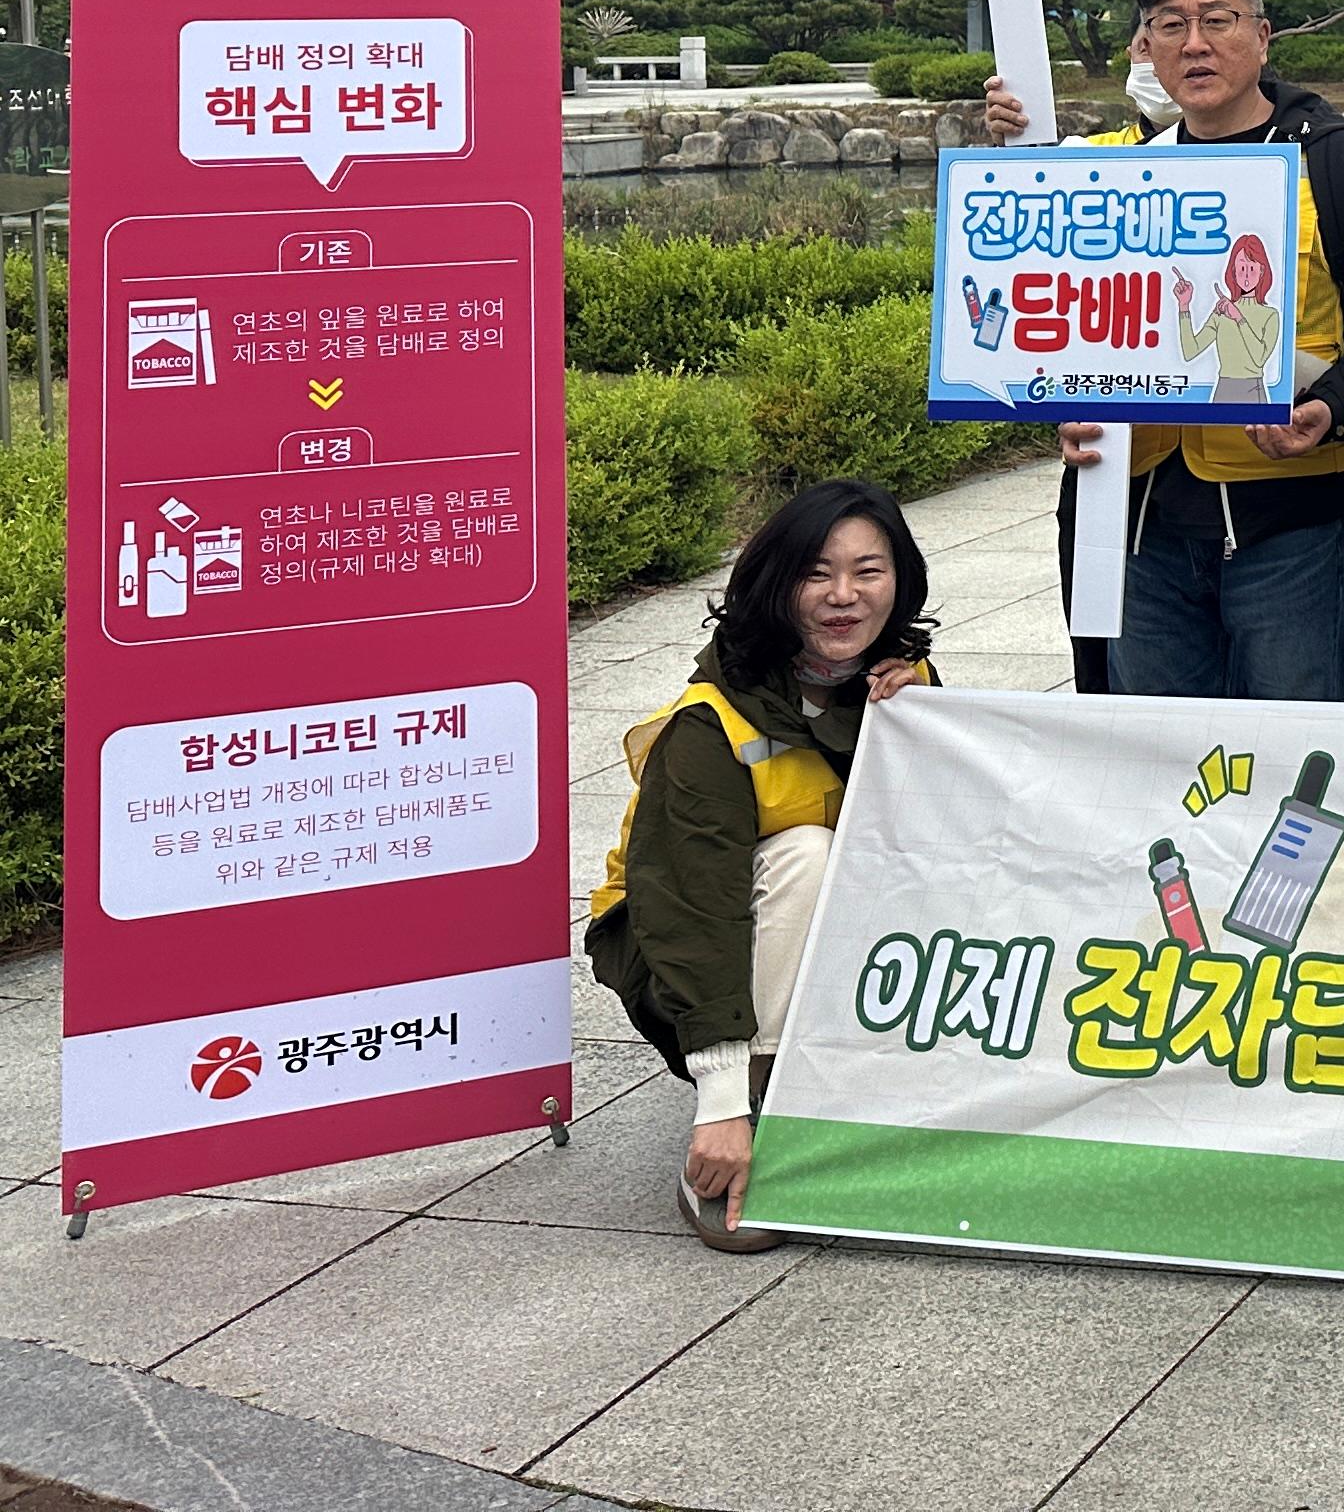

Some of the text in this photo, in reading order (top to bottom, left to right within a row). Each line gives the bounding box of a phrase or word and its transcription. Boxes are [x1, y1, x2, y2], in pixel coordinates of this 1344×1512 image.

[224, 42, 424, 72] 담배 정의 확대
[205, 82, 443, 136] 핵심 변화
[963, 189, 1231, 261] 전자담배도
[299, 240, 352, 266] 기존
[232, 297, 504, 336] 연초의 잎을 원료로 하여
[1011, 271, 1162, 353] 담배!
[133, 354, 192, 370] TOBACCO
[232, 327, 504, 365] 제조한 것을 담배로 정의
[300, 437, 352, 464] 변경
[259, 488, 513, 529] 연초나 니코틴을 원료로
[259, 514, 520, 556] 하여 제조한 것을 담배로
[198, 567, 238, 583] TOBACCO
[259, 544, 483, 586] 정의(규제 대상 확대)
[180, 704, 467, 772] 합성니코틴 규제
[126, 751, 516, 824] 담배사업법 개정에 따라 합성니코틴
[151, 791, 492, 858] 등을 원료로 제조한 담배제품도
[216, 835, 434, 885] 위와 같은 규제 적용
[856, 929, 1054, 1060] 이제
[277, 1012, 459, 1074] 광주광역시
